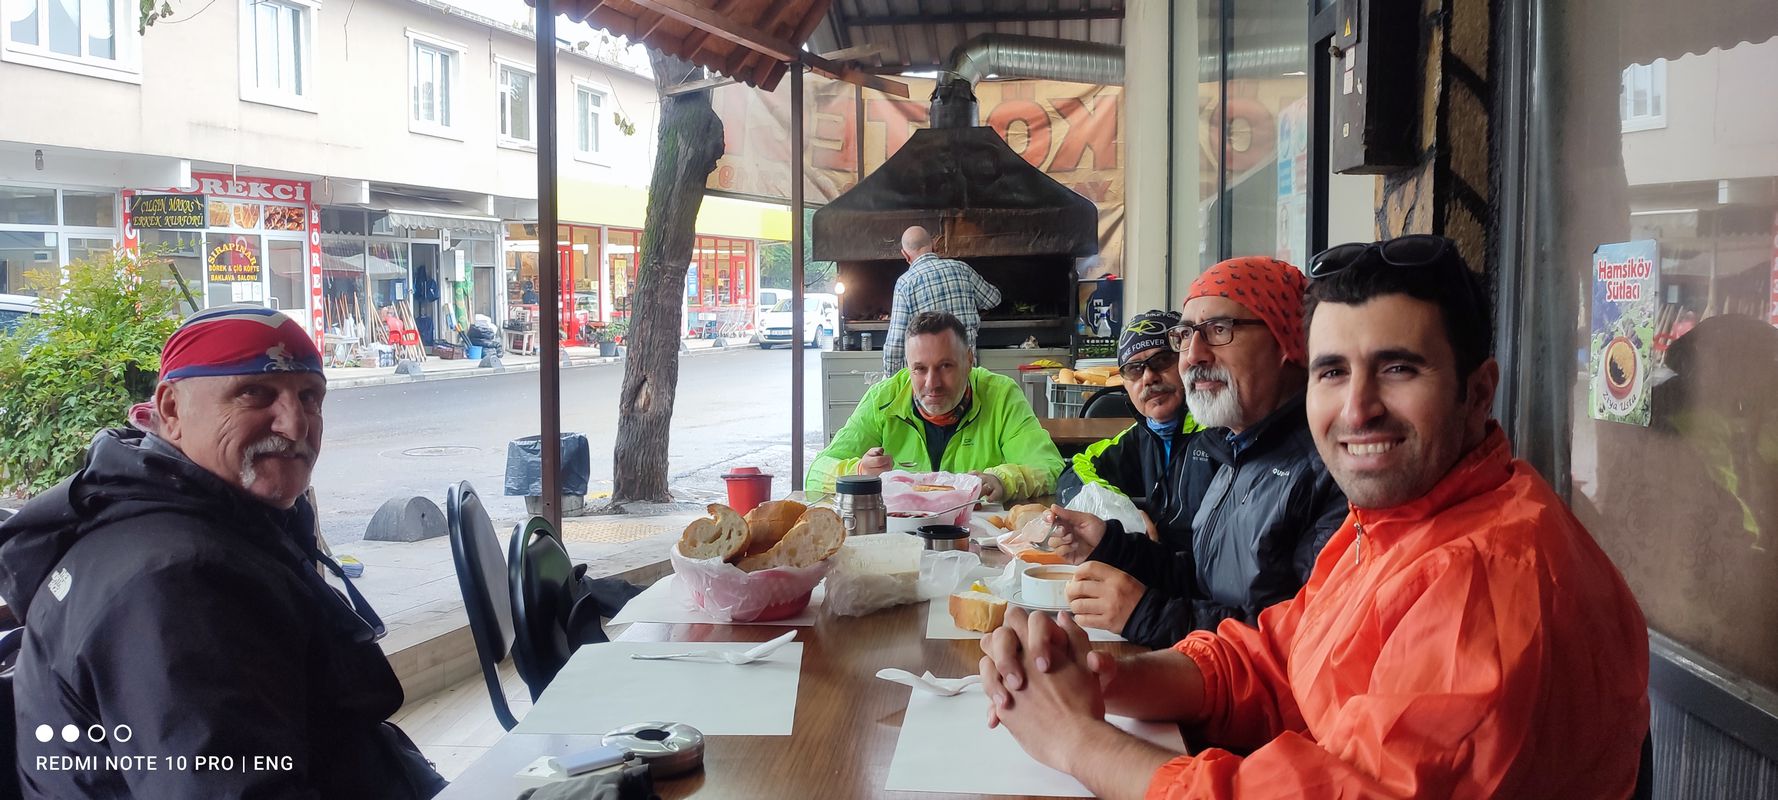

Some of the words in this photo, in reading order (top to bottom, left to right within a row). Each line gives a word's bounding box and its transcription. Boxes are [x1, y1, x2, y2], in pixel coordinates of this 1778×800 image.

[141, 197, 167, 215] ÇILGIN
[169, 197, 194, 213] MAKAS
[133, 215, 162, 227] ERKEK
[164, 213, 203, 227] KUAFÖRÜ
[208, 243, 257, 265] SIRAPINAR
[209, 264, 227, 272] BÖREK
[243, 264, 260, 272] KÖFTE
[1599, 259, 1652, 281] Hamsiköy
[1607, 281, 1640, 301] Sütlacı
[1121, 347, 1132, 362] BIKE
[1131, 339, 1165, 351] FOREVER
[1603, 392, 1618, 410] Ziya
[1620, 394, 1637, 411] Usta
